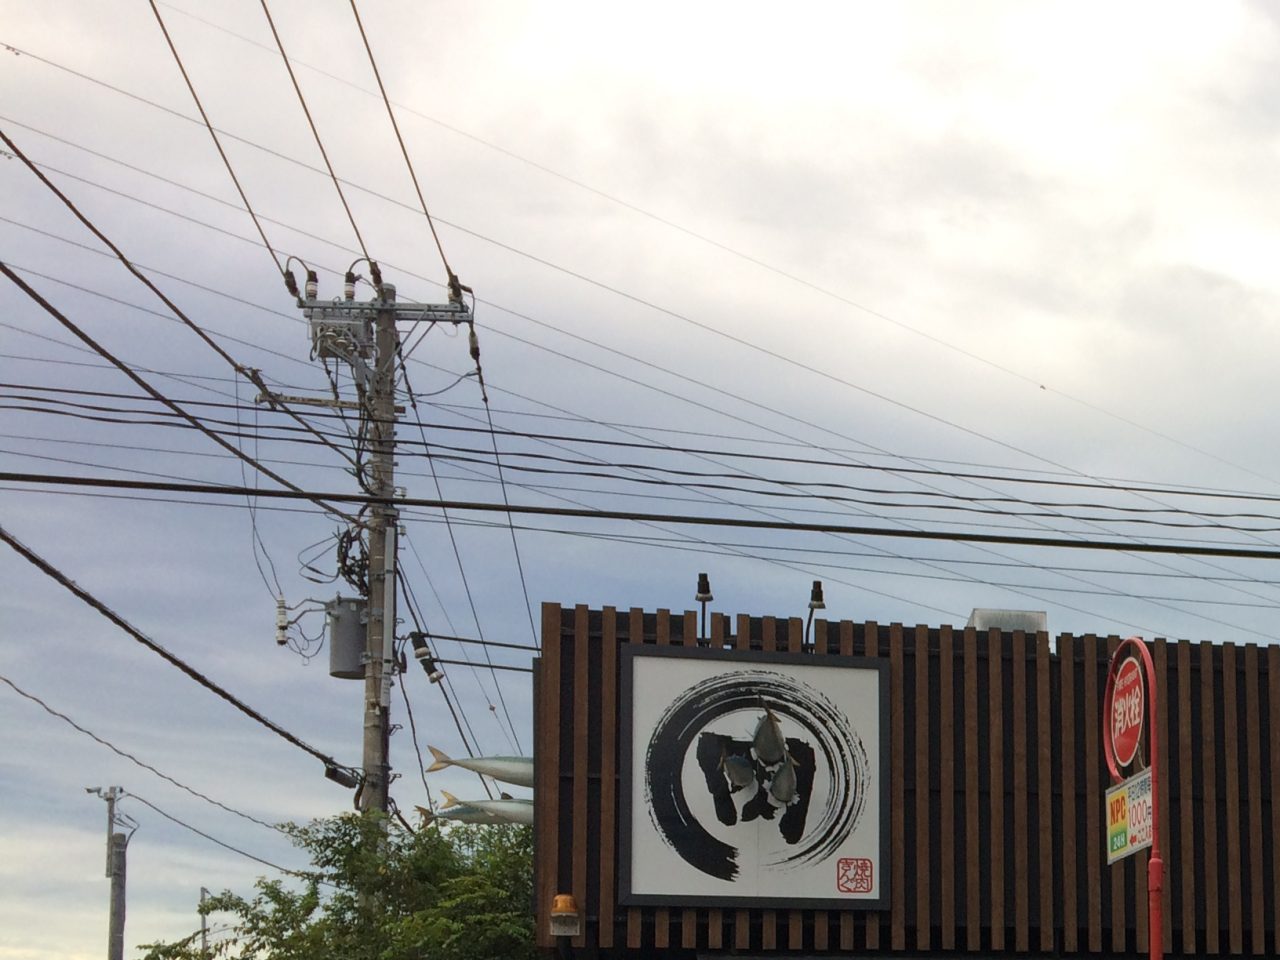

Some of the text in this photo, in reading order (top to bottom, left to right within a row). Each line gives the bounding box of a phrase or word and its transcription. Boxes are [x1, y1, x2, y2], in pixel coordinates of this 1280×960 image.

[1115, 685, 1141, 738] 消火栓
[1110, 795, 1126, 826] NPC
